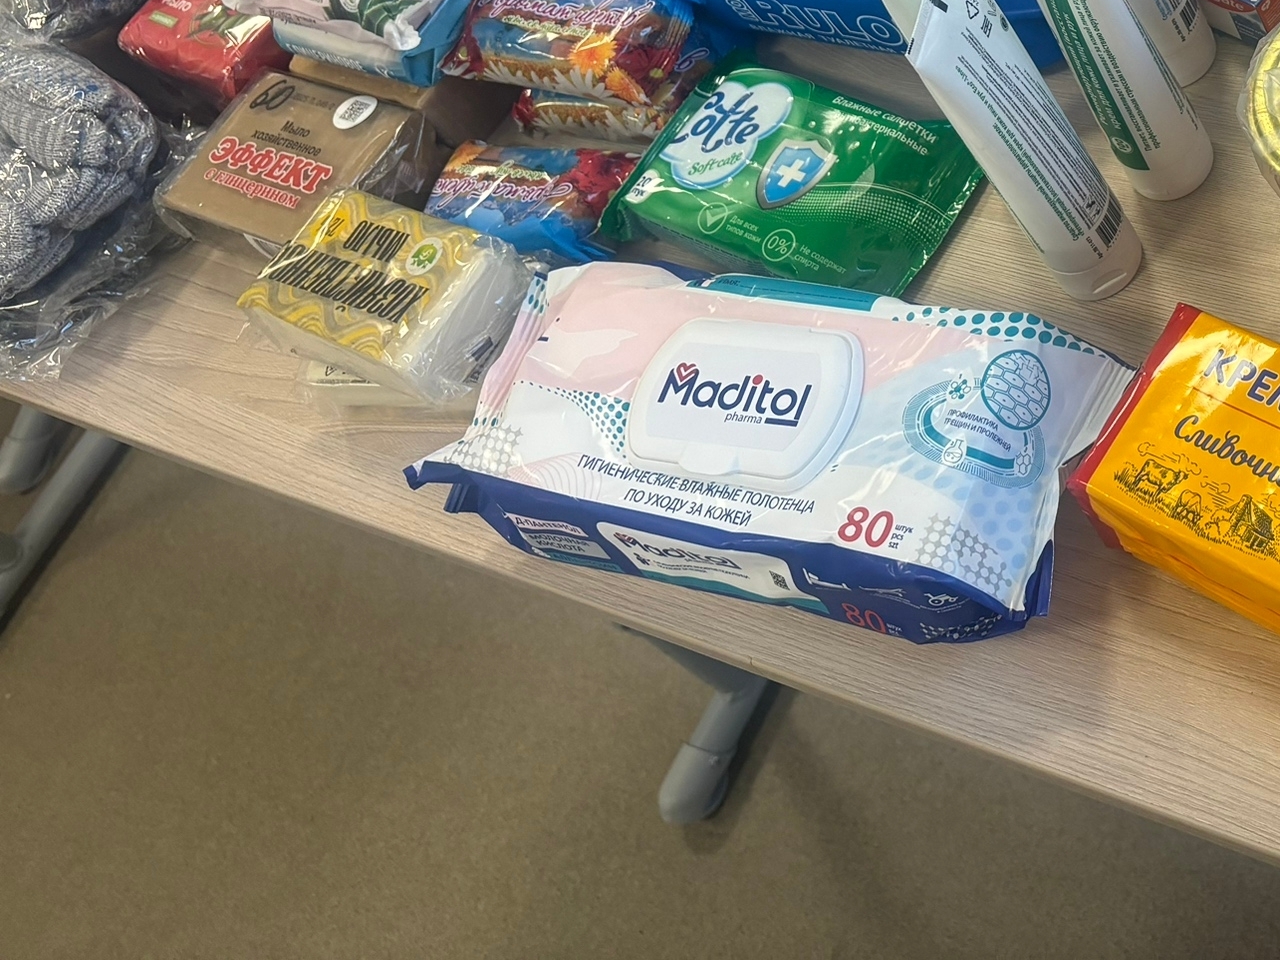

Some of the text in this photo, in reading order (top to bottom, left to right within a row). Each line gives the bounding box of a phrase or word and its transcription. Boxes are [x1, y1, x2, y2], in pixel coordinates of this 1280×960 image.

[280, 120, 311, 138] Мыло
[831, 95, 938, 144] Влажные салфетки
[251, 128, 322, 157] хозяйственное
[208, 135, 333, 194] ЭФФЕКТ
[214, 170, 302, 209] глицерином
[725, 223, 762, 244] типов кожи
[730, 214, 760, 233] Для всех
[343, 219, 412, 265] МЫЛО
[767, 234, 788, 255] 0%
[793, 252, 821, 272] спирта
[800, 244, 847, 275] Не содержат
[723, 411, 762, 426] pharma
[947, 408, 999, 432] ПРОФИЛАКТИКА
[943, 417, 1013, 454] ТРЕЩИН ПРОЛЕЖНЕЙ
[577, 454, 816, 514] ГИГИЕНИЧЕСКИЕ ВЛАЖНЫЕ ПОЛОТЕНЦА
[624, 487, 753, 527] ПО УХОДУ ЗА КОЖЕЙ
[514, 516, 582, 535] Д-ПАНТЕНОЛ
[837, 506, 894, 548] 80
[895, 524, 914, 535] штук
[528, 533, 590, 548] МОЛОЧНАЯ
[536, 539, 586, 554] КИСЛОТА
[888, 541, 899, 550] szt
[890, 532, 904, 542] pcs
[841, 602, 887, 635] 80
